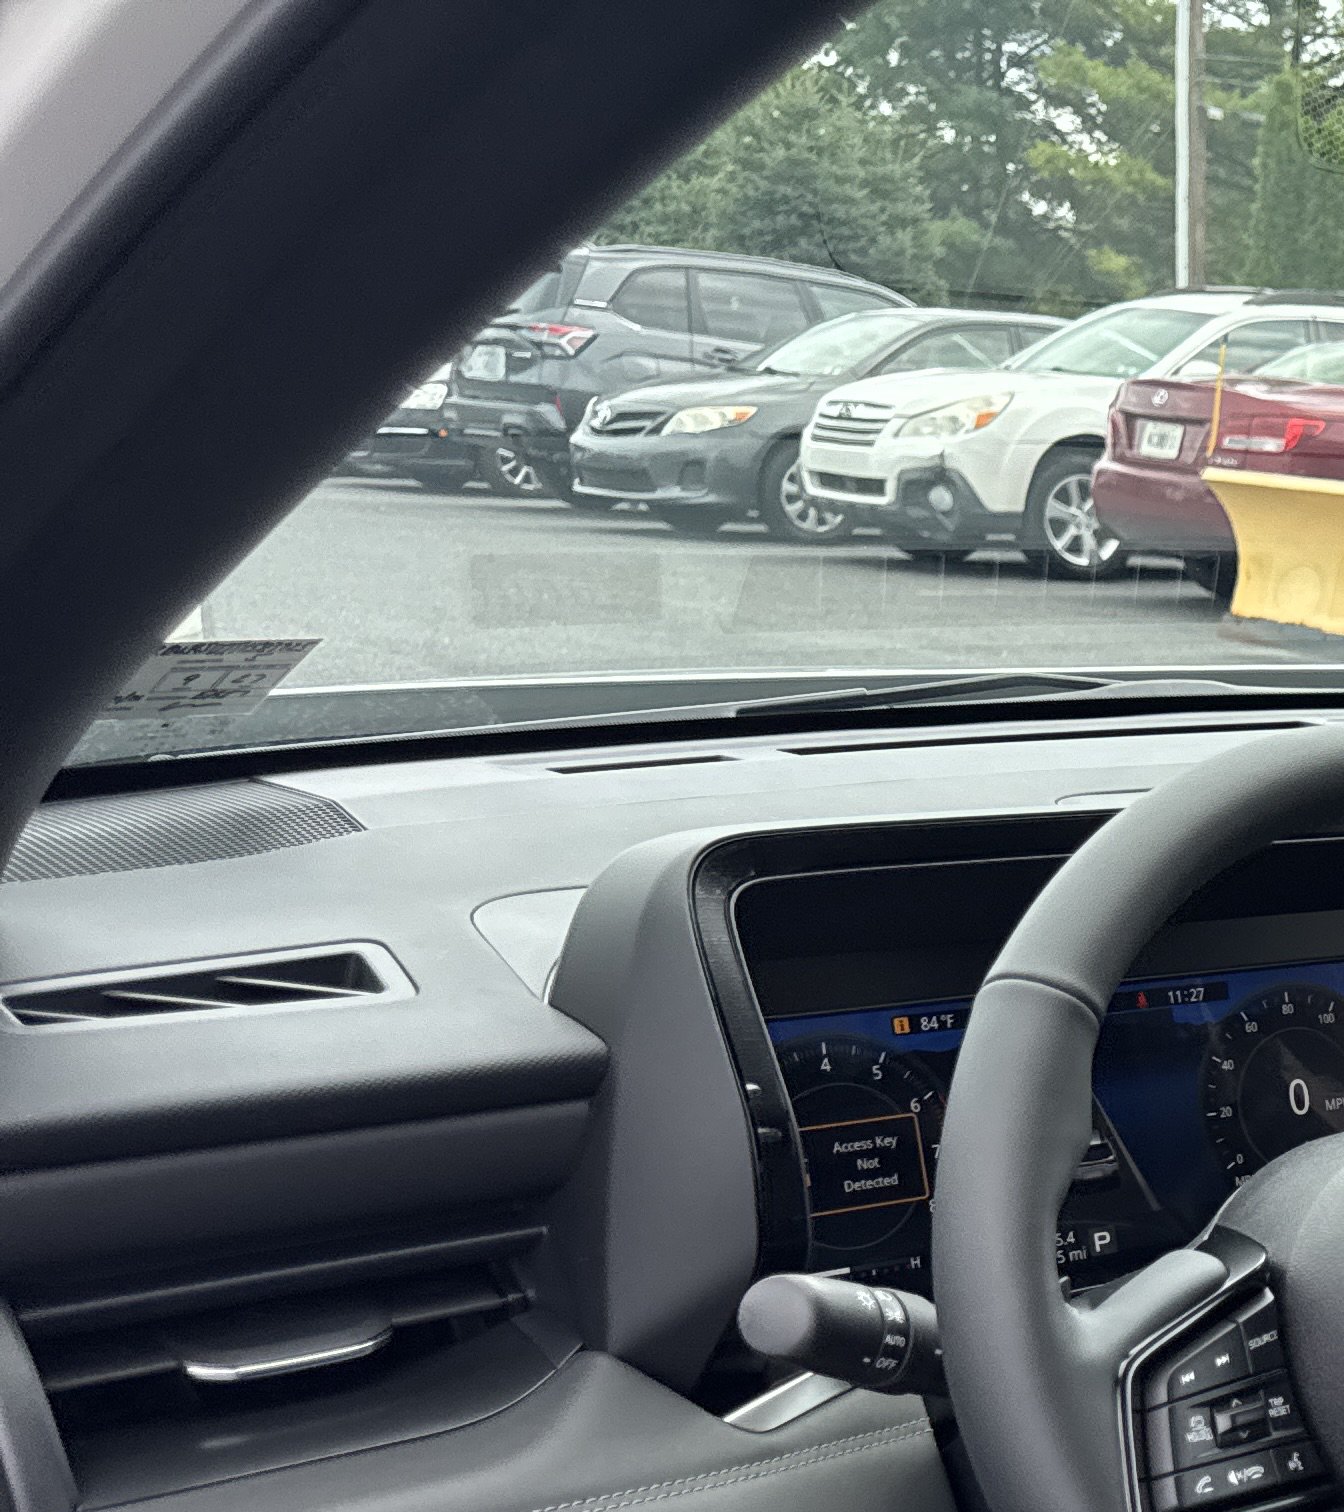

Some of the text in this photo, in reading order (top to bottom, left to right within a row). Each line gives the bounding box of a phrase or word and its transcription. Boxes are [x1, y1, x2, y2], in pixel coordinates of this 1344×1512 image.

[1167, 987, 1205, 1004] 11:27
[1281, 1003, 1294, 1015] 80
[920, 1014, 955, 1031] 84°F
[1318, 1012, 1335, 1024] 100
[1245, 1021, 1258, 1033] 60
[820, 1057, 831, 1072] 4
[1221, 1059, 1234, 1071] 40
[872, 1065, 882, 1080] 5
[1289, 1078, 1309, 1115] 0
[910, 1098, 921, 1113] 6
[1219, 1106, 1232, 1118] 20
[833, 1136, 898, 1154] Access Key
[856, 1157, 880, 1170] Not
[844, 1173, 899, 1193] Detected
[1093, 1231, 1111, 1253] P
[1069, 1246, 1088, 1261] mi
[910, 1256, 921, 1268] H
[884, 1334, 906, 1348] AUTO
[875, 1356, 899, 1370] OFF
